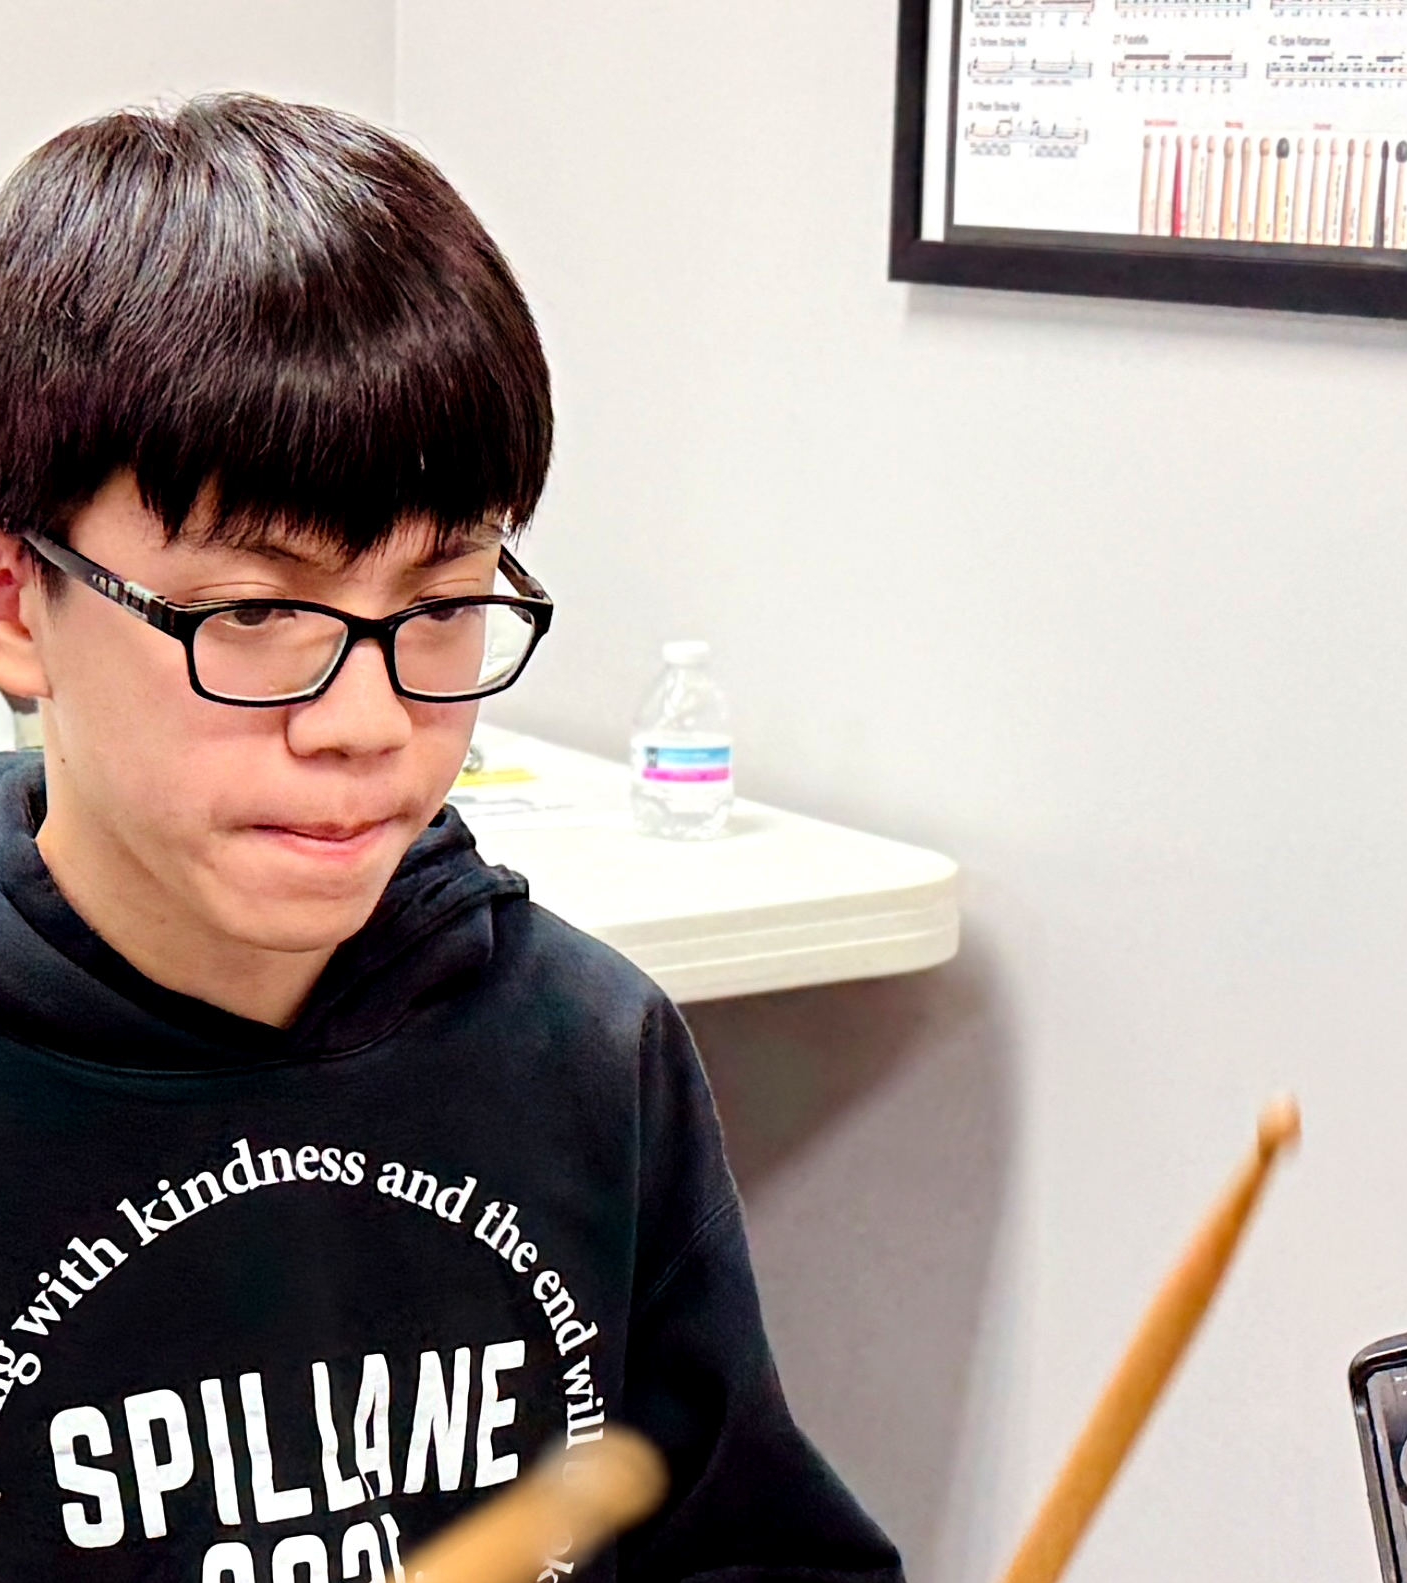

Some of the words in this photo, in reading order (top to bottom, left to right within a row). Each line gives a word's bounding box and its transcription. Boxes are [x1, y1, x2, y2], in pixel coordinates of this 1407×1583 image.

[116, 1138, 367, 1247] kindness
[377, 1161, 478, 1223] and
[473, 1201, 539, 1273] the
[11, 1237, 129, 1337] with
[533, 1270, 599, 1356] end
[50, 1340, 526, 1549] SPILLANE
[563, 1355, 605, 1449] will
